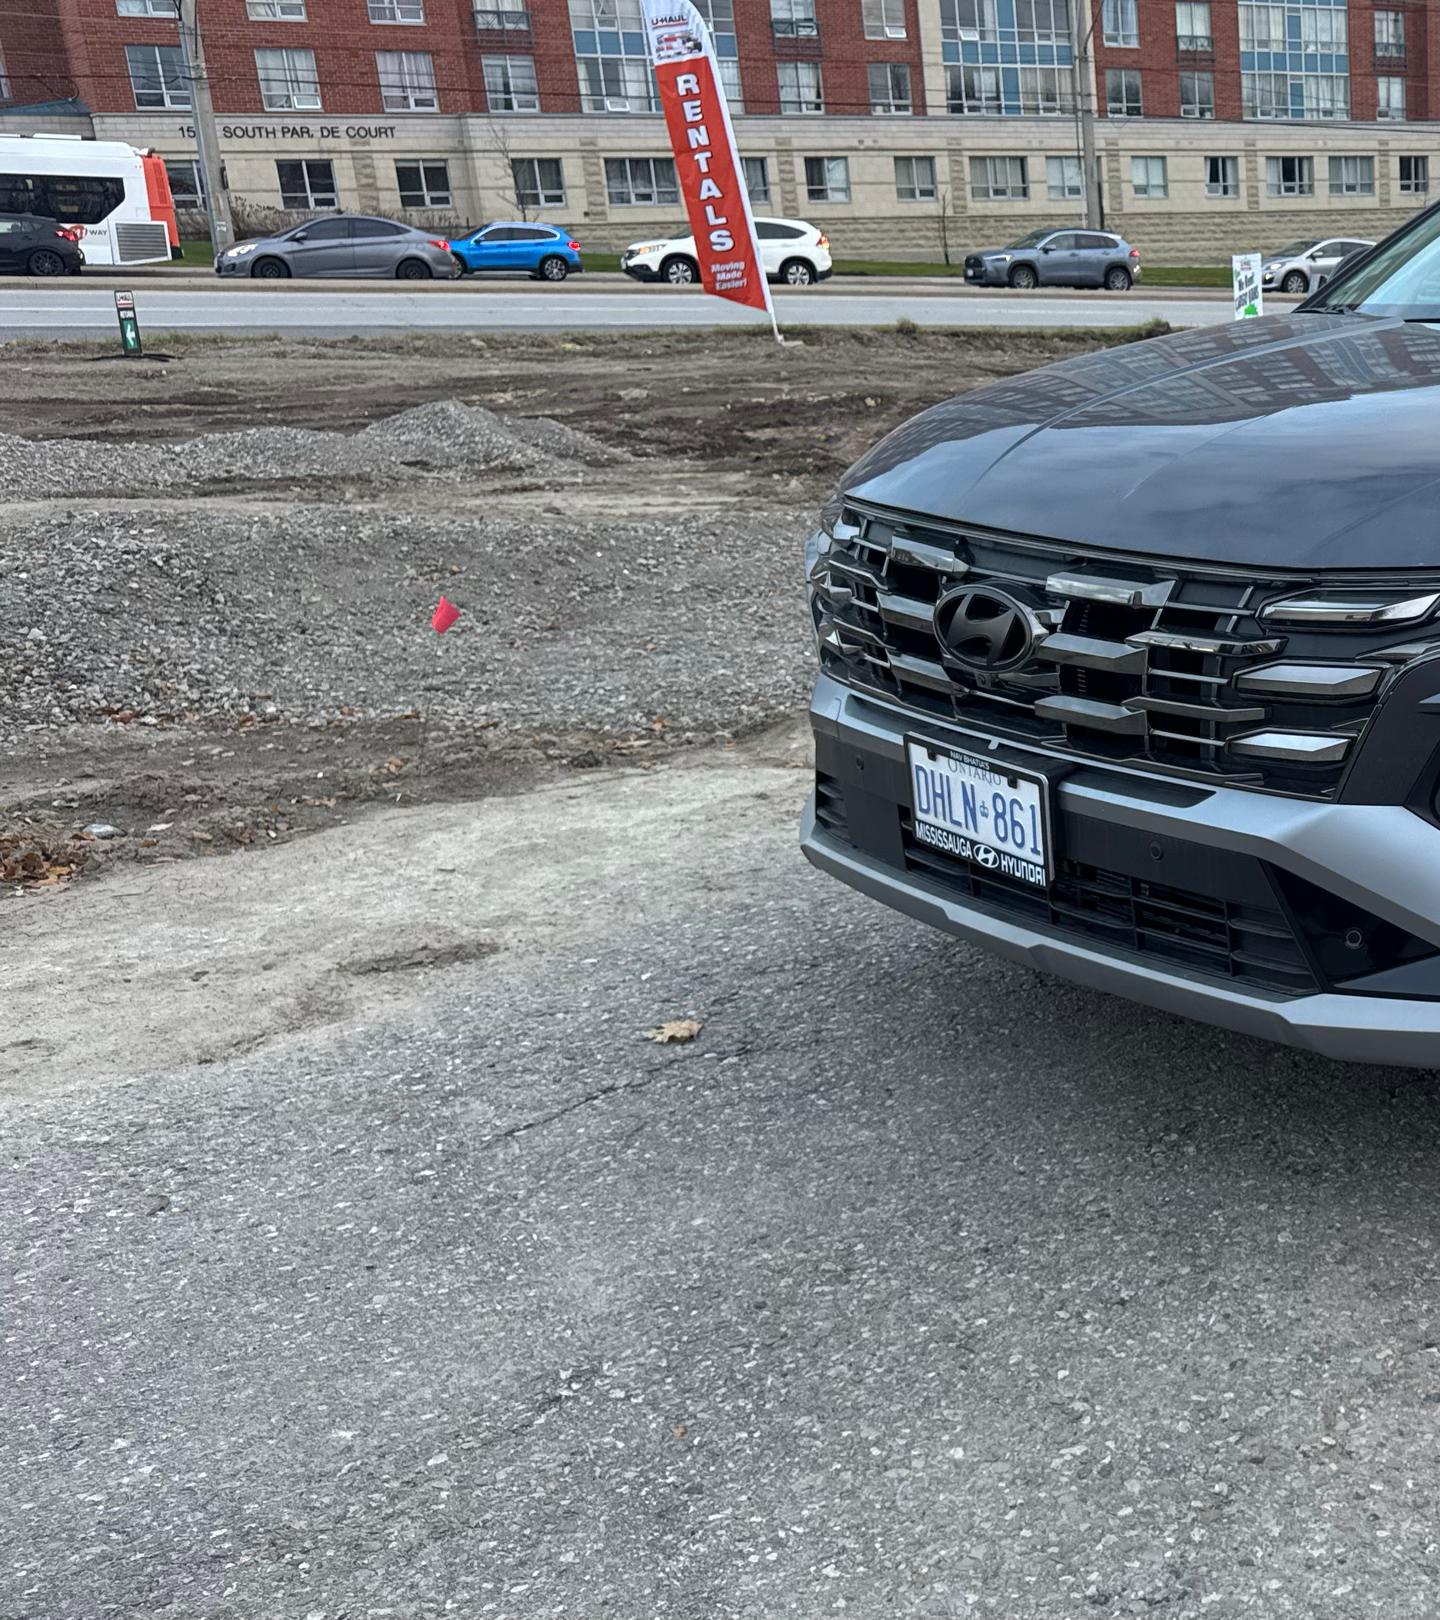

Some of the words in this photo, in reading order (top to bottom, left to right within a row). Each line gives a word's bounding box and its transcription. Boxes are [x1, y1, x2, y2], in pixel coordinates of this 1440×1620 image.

[222, 126, 277, 139] SOUTH
[345, 126, 396, 139] COURT
[675, 73, 735, 252] RENTALS
[711, 261, 745, 273] Moving
[716, 270, 742, 281] Made
[948, 759, 1002, 787] ONTARIO
[914, 764, 979, 834] DHLN
[992, 792, 1042, 856] 861
[915, 820, 974, 860] MISSISSAUGA
[1000, 853, 1046, 887] HYUNDAI
